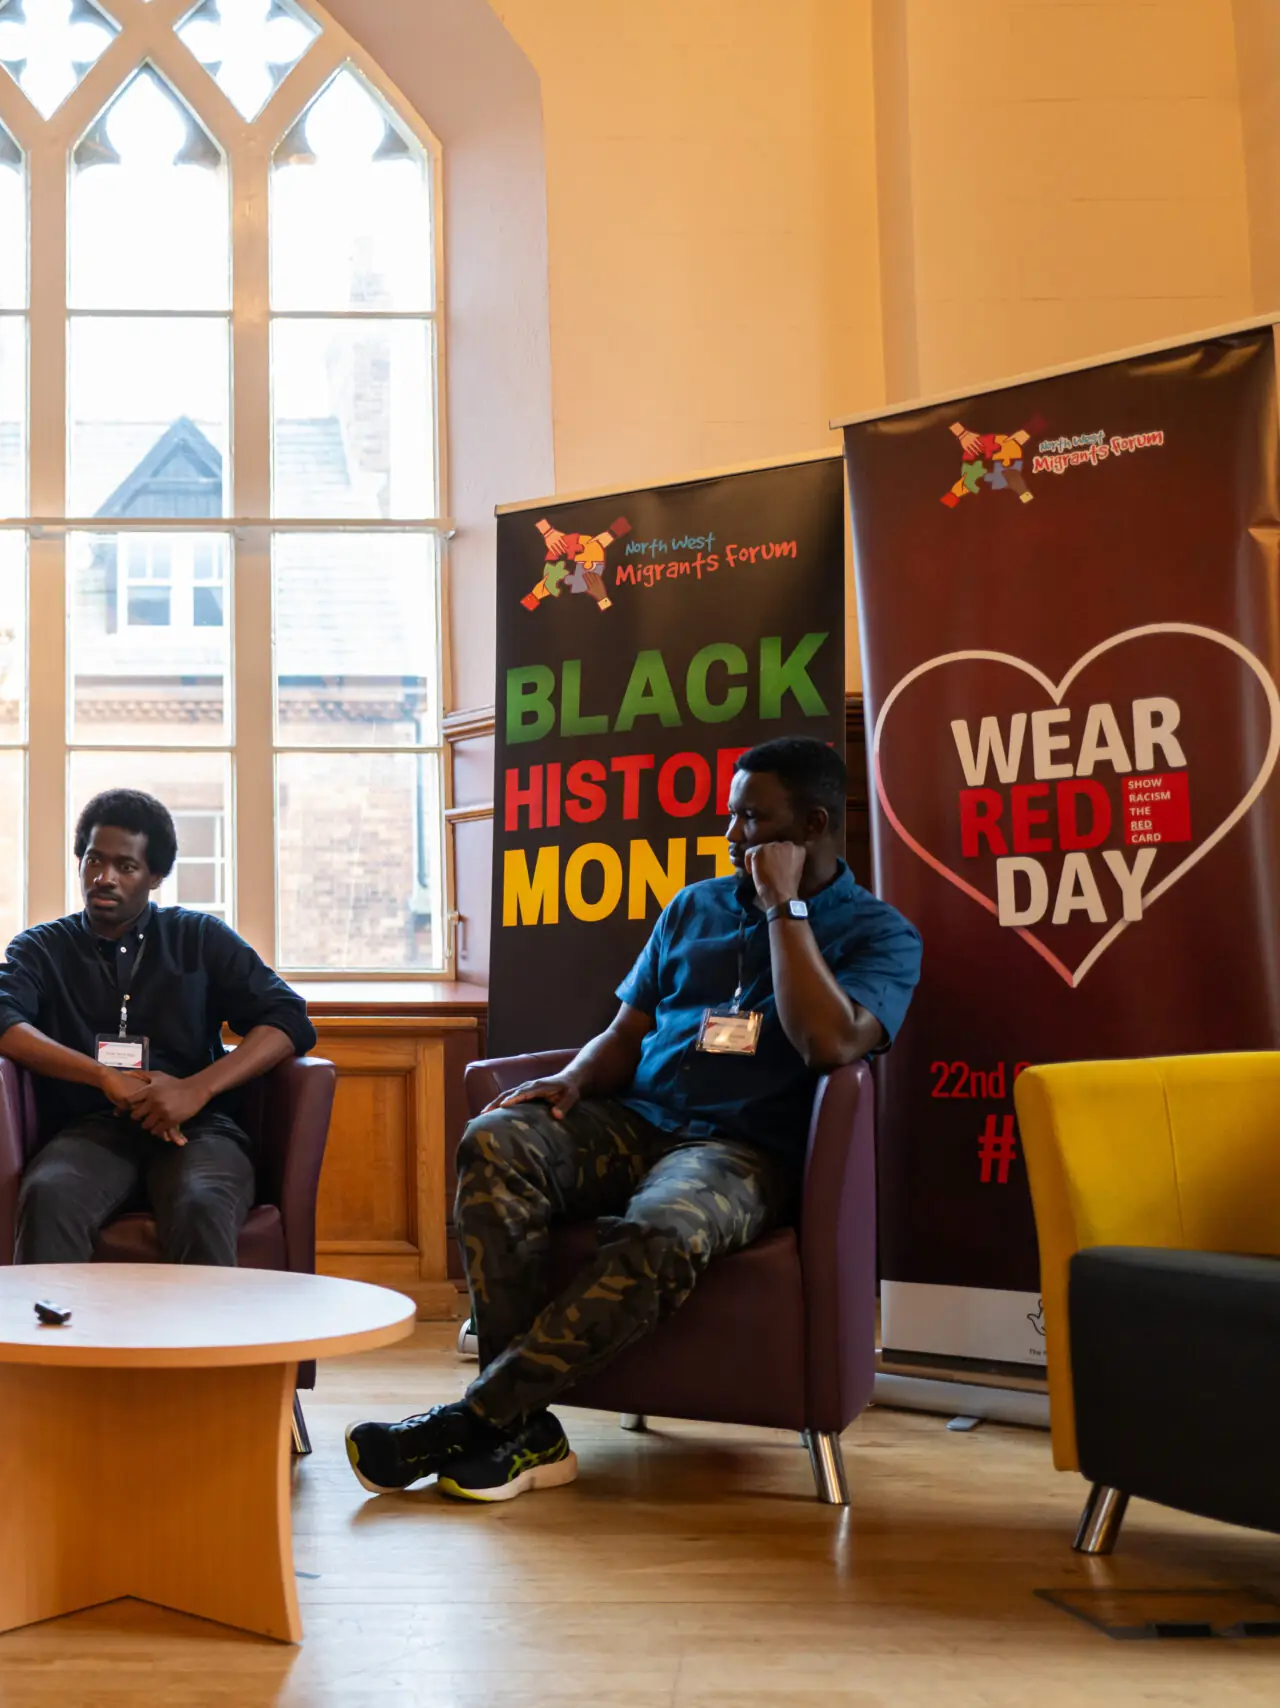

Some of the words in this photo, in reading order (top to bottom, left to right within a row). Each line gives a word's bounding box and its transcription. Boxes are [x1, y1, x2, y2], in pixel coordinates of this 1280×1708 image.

[1032, 444, 1109, 474] Migrants
[625, 538, 668, 559] North
[671, 531, 715, 552] West
[615, 552, 719, 587] Migrants
[506, 631, 830, 745] BLACK
[950, 696, 1187, 786] WEAR
[504, 747, 754, 831] HISTO
[1128, 778, 1162, 789] SHOW
[1128, 790, 1171, 803] RACISM
[959, 778, 1112, 858] RED
[1129, 806, 1151, 816] THE
[1130, 820, 1152, 830] RED
[1131, 833, 1161, 843] CARD
[996, 847, 1158, 927] DAY
[930, 1061, 1006, 1098] 22nd
